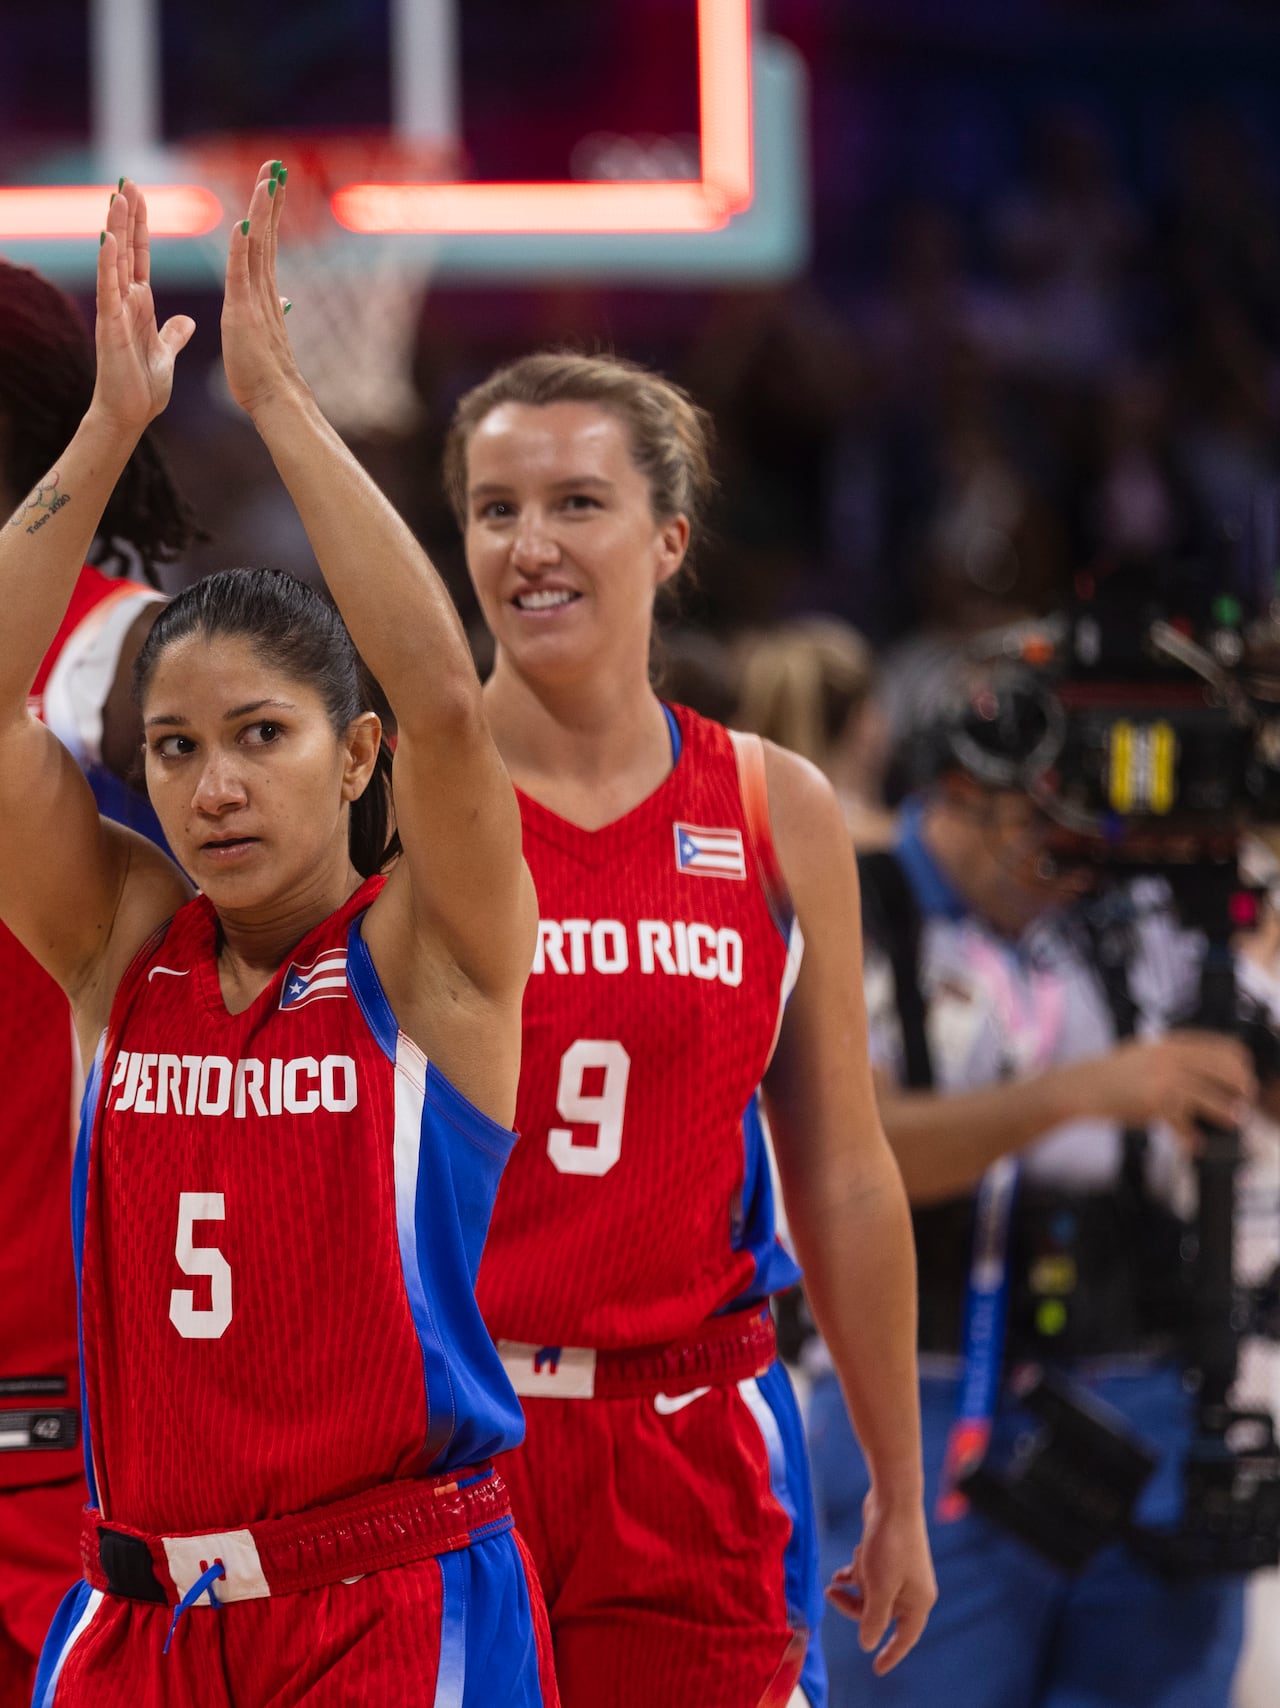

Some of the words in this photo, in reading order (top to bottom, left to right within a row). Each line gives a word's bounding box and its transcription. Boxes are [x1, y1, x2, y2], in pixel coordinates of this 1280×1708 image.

[532, 919, 629, 975] RTO
[637, 919, 743, 988] RICO
[105, 1050, 233, 1116] PUERTO
[234, 1055, 357, 1118] RICO
[547, 1039, 631, 1177] 9
[169, 1192, 232, 1338] 5
